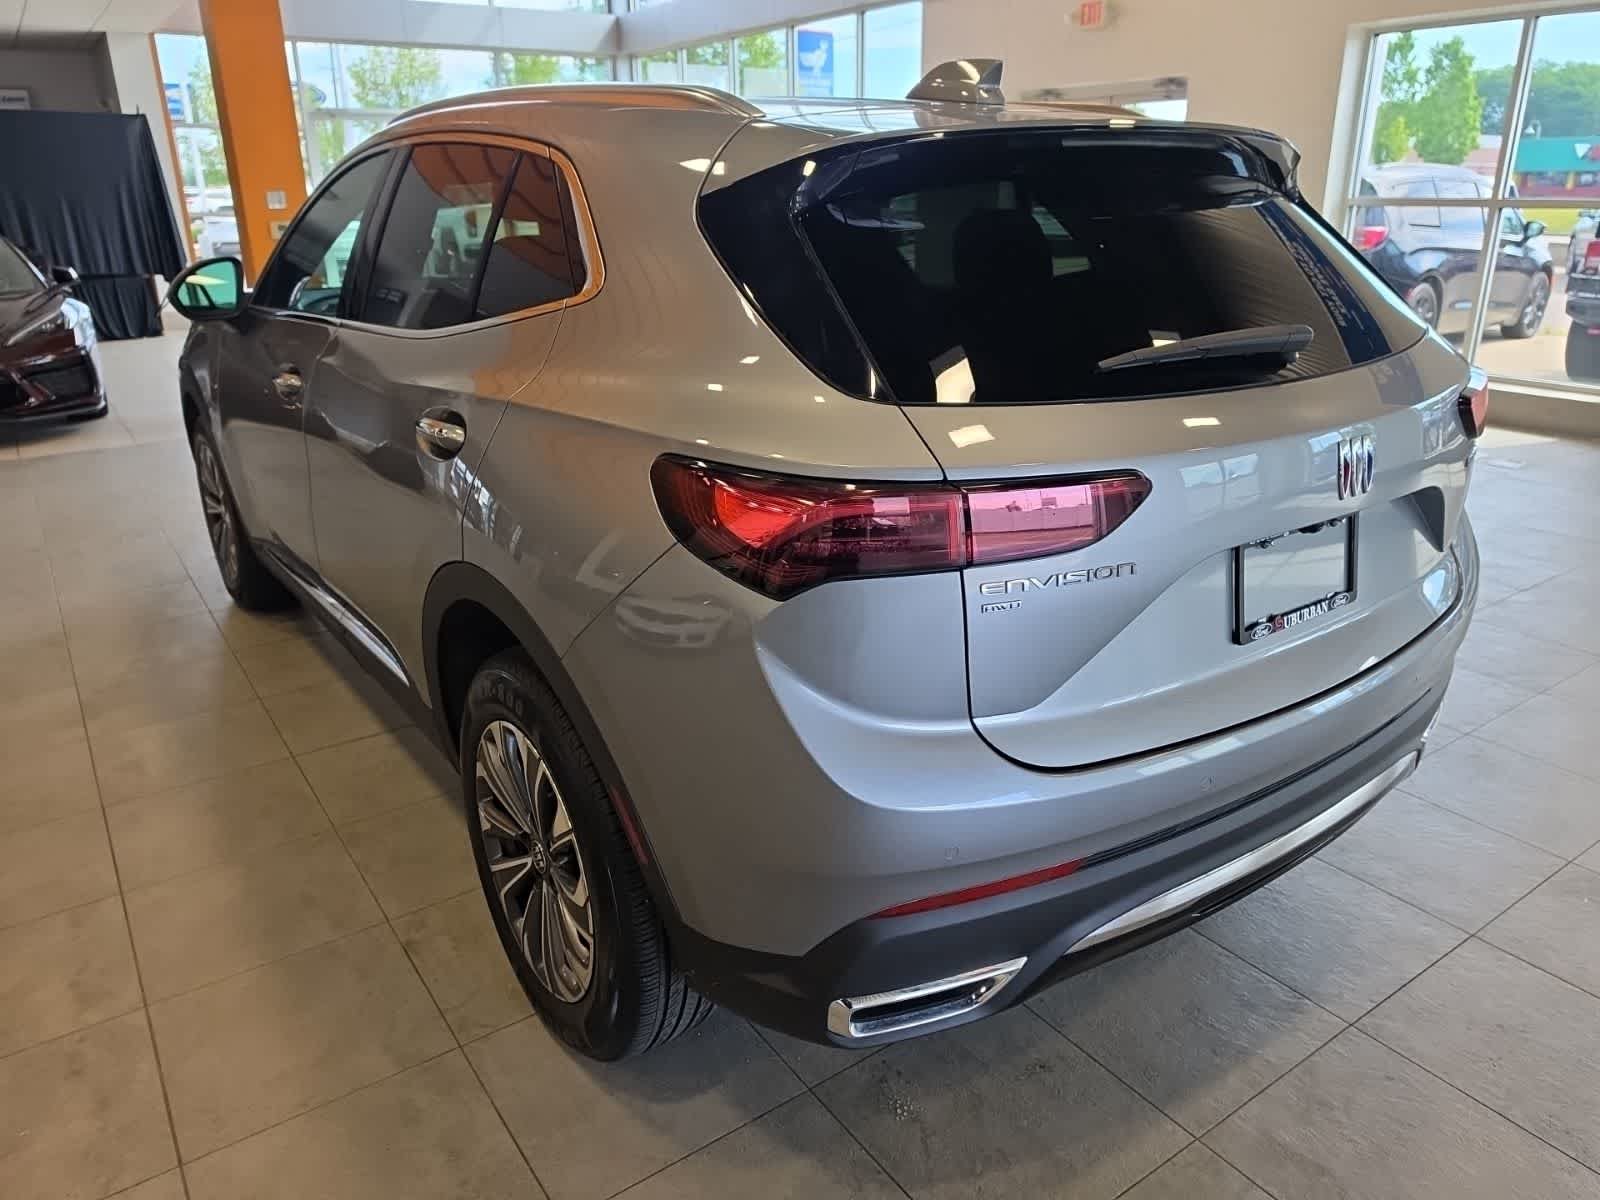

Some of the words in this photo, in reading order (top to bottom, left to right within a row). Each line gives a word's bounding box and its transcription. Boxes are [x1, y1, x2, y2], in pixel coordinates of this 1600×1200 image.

[979, 562, 1137, 596] ENVISION
[981, 600, 1022, 614] AWD
[1275, 600, 1328, 629] SUBURBAN
